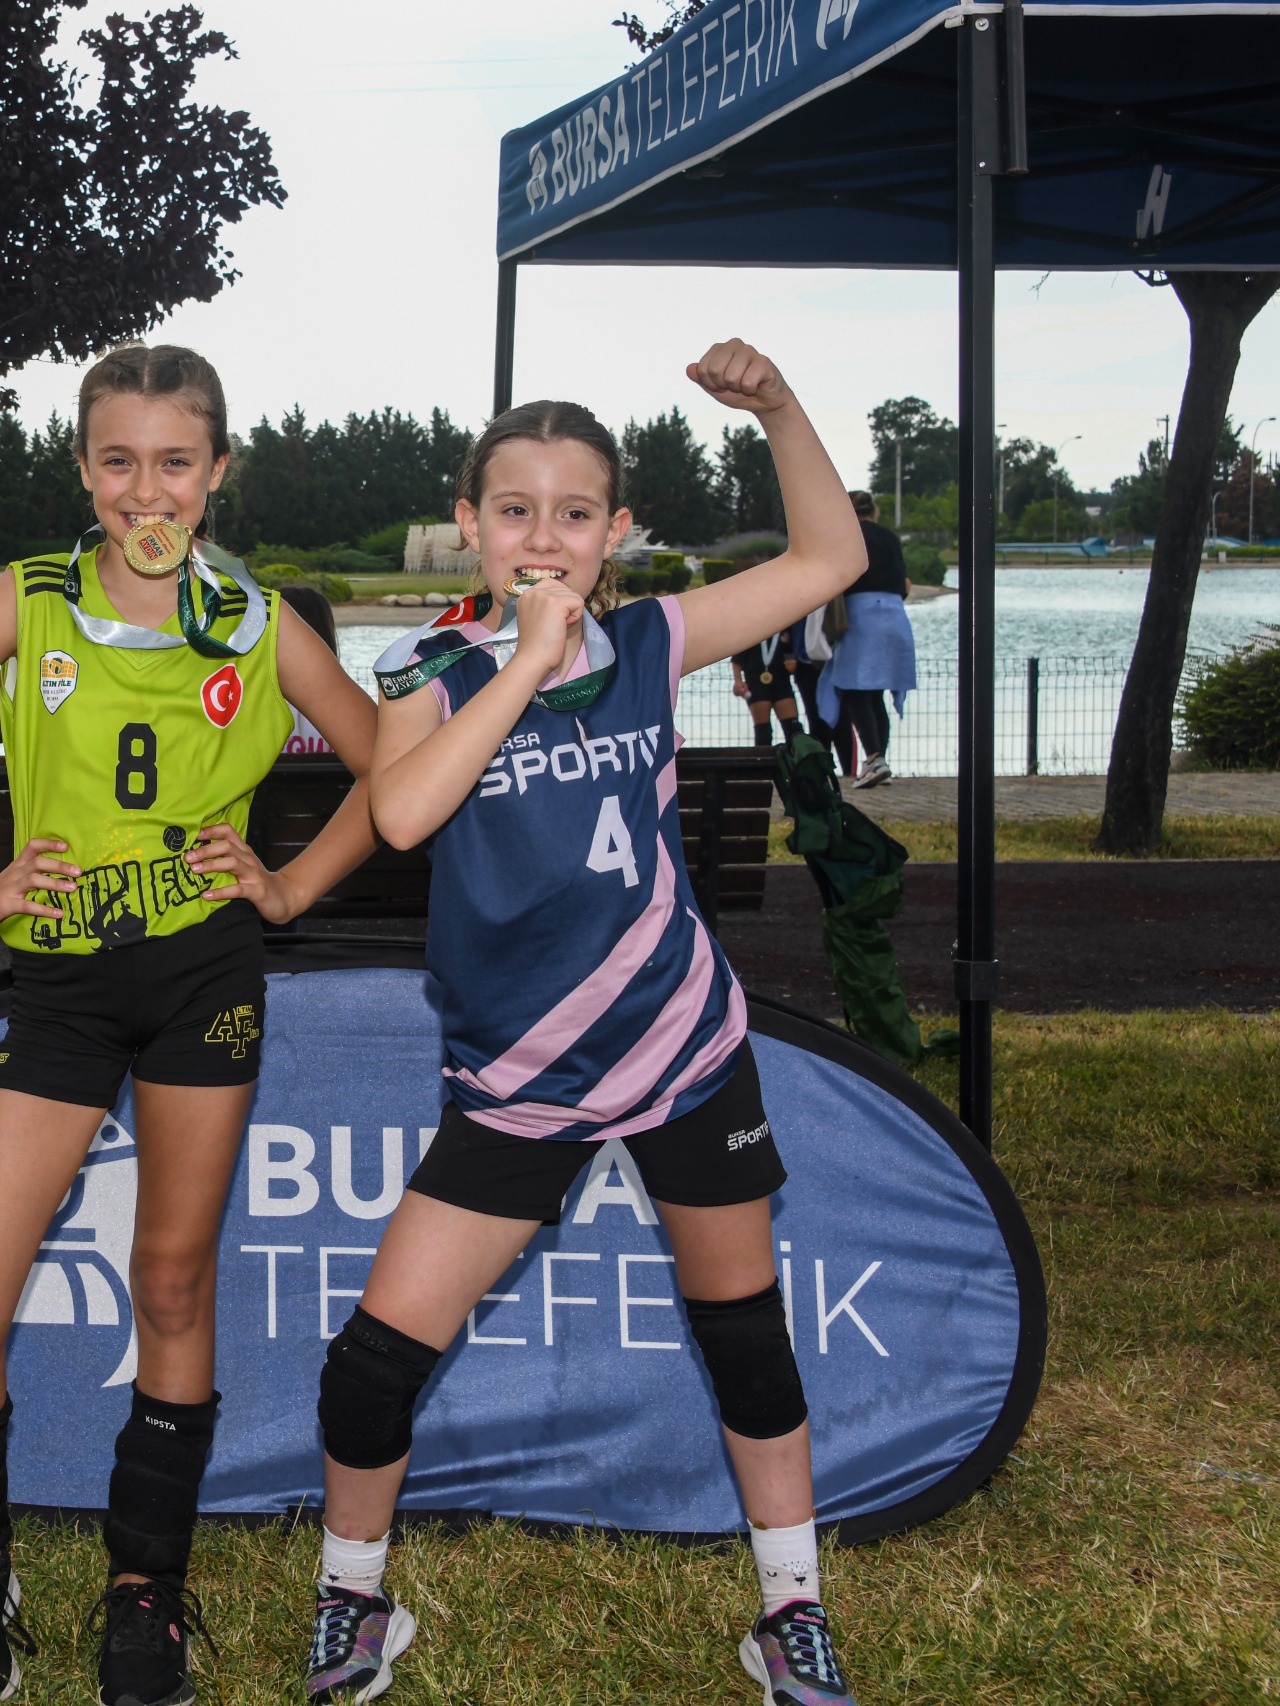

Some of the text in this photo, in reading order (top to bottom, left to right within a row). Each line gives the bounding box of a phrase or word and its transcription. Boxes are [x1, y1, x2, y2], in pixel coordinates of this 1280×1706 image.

[551, 85, 629, 205] BURSA
[139, 538, 158, 560] AYDIN
[146, 534, 165, 557] ERKAN
[392, 667, 420, 684] ERKAN
[499, 732, 541, 754] RSA
[115, 722, 158, 810] 8
[585, 795, 639, 888] 4
[728, 1129, 746, 1139] BURSA
[247, 1123, 660, 1225] BUA
[240, 1240, 891, 1357] TEEFEİK
[145, 1415, 177, 1431] KIPSTA
